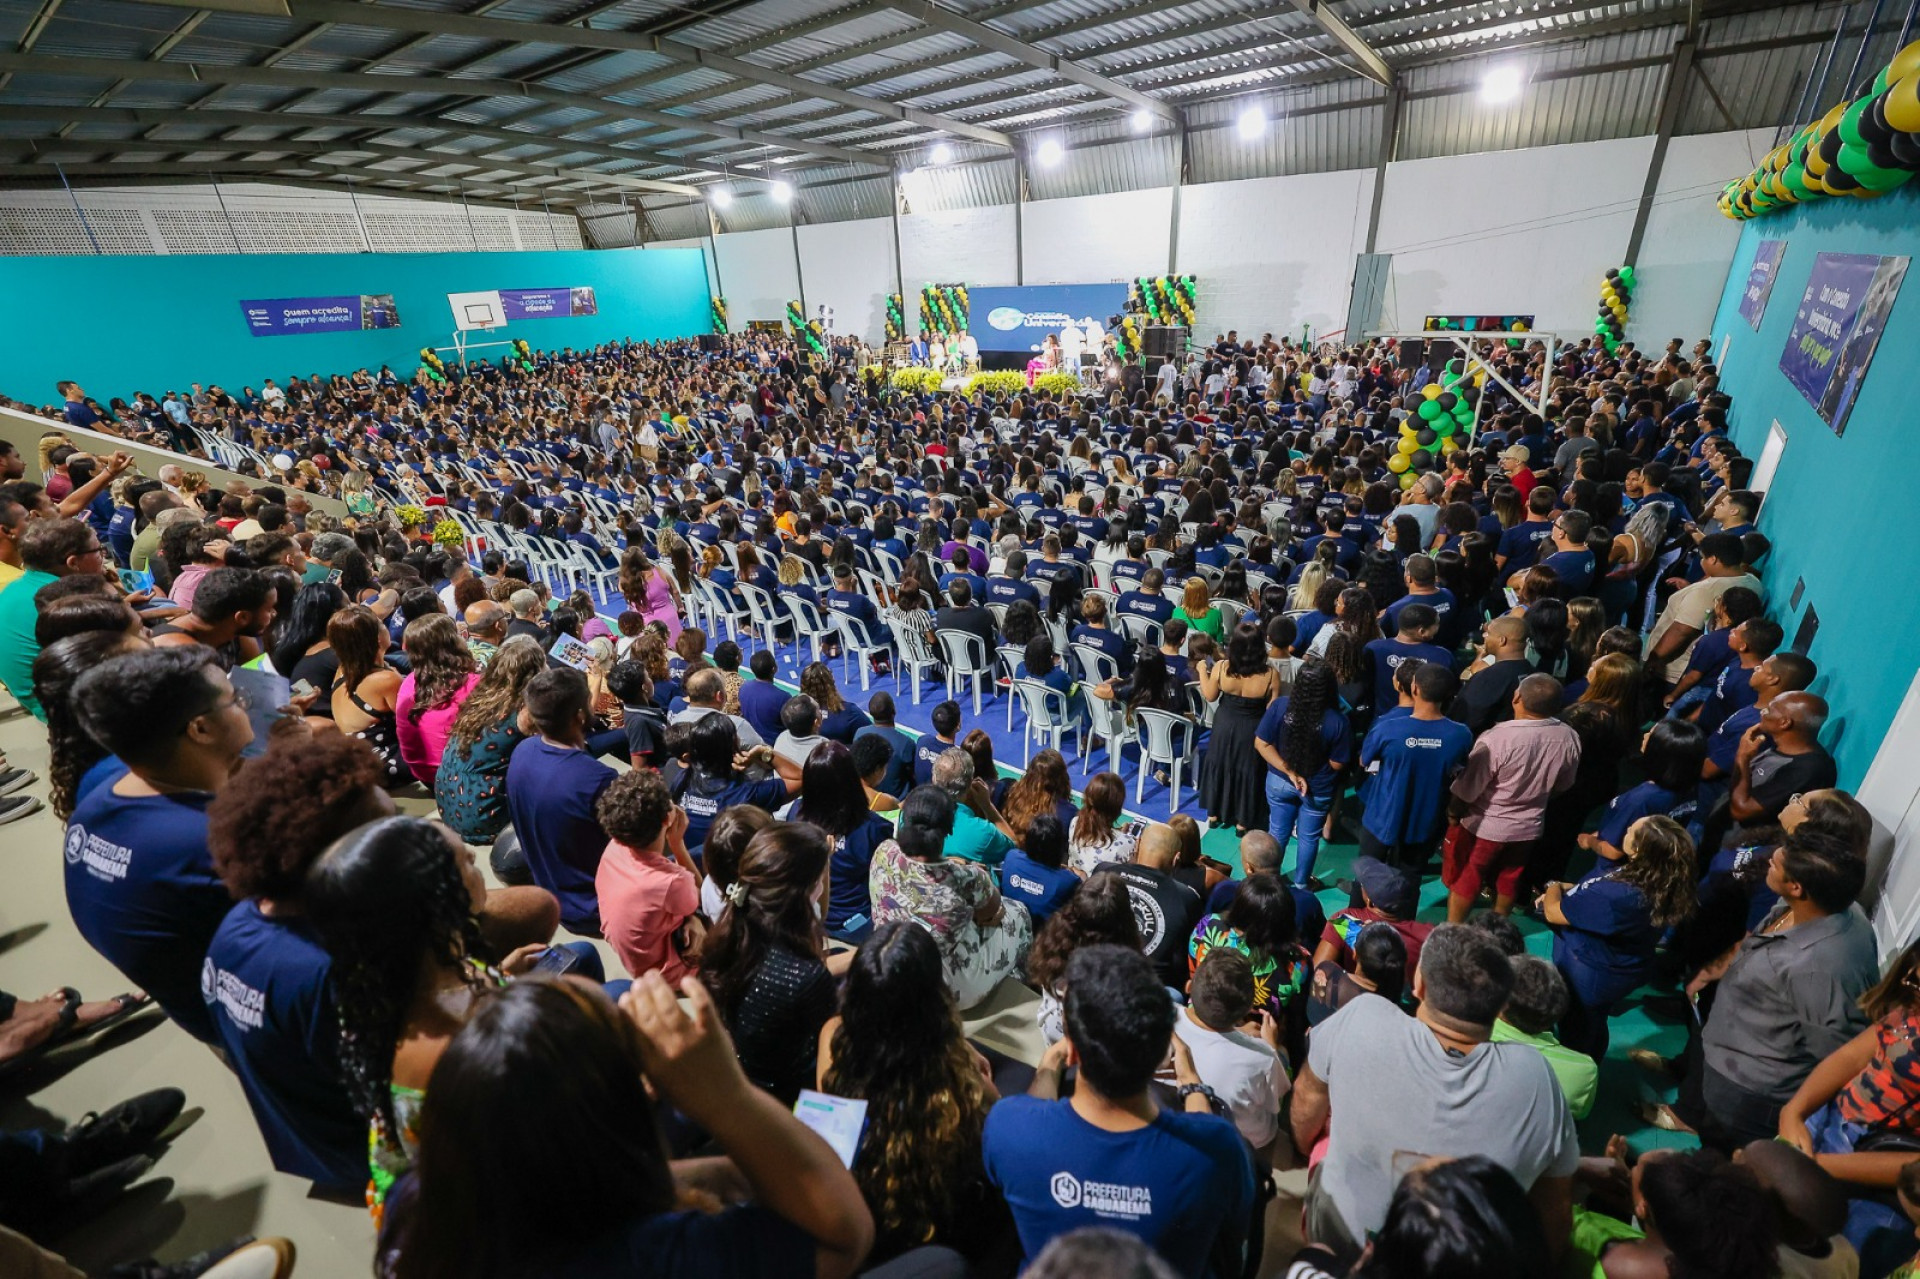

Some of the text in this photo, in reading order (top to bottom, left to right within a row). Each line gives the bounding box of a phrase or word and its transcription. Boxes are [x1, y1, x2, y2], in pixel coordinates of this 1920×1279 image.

[283, 306, 349, 317] Quem acredita
[283, 316, 316, 328] sempre
[87, 833, 133, 865] PREFEITURA
[217, 968, 265, 1012] PREFEITURA
[1082, 1180, 1152, 1202] PREFEITURA
[1082, 1194, 1152, 1215] SAQUAREMA
